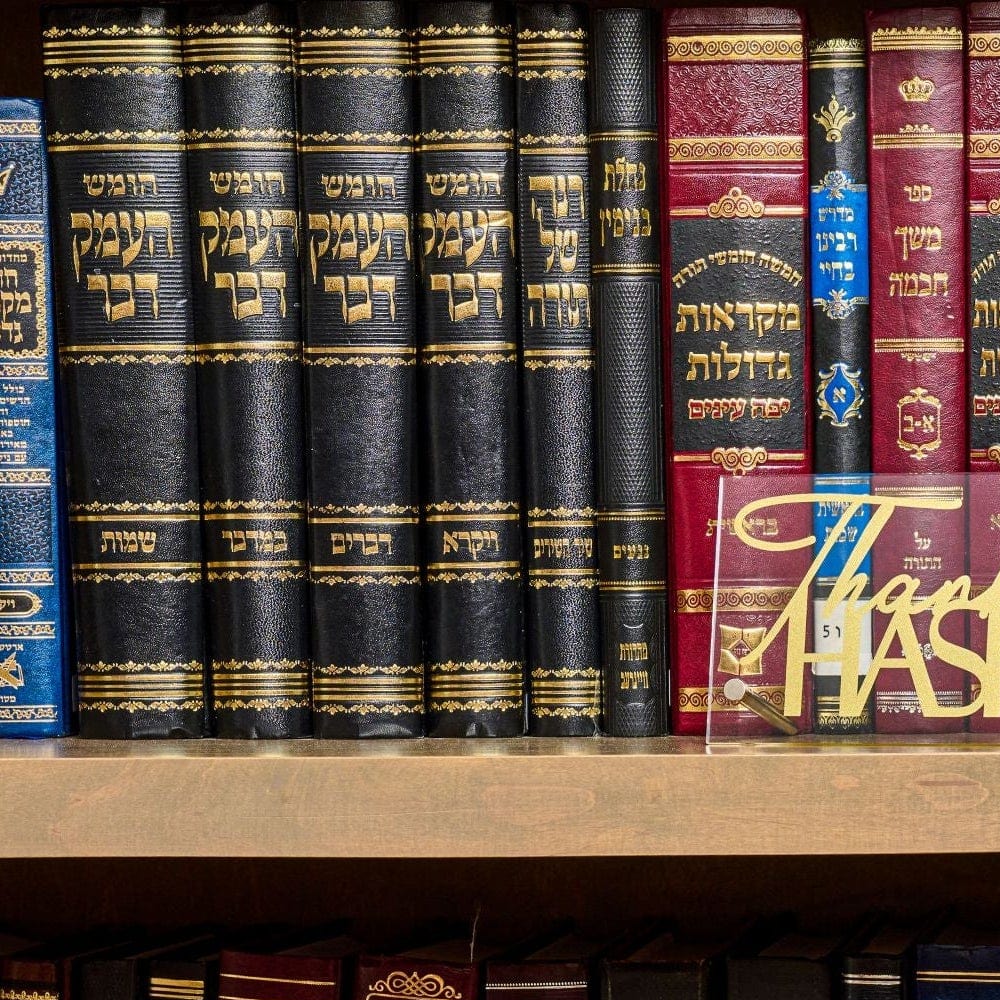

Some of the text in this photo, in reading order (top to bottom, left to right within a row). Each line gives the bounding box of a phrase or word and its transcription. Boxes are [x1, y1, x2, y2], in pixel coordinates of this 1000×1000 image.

[83, 172, 158, 196] חומש
[209, 171, 286, 195] חומש
[321, 173, 396, 198] חומש
[426, 171, 500, 197] חומש
[603, 156, 647, 191] נחלת
[903, 185, 932, 202] ספר
[600, 207, 652, 247] בנימין
[819, 206, 855, 222] מדרש
[71, 208, 174, 283] העמק
[199, 207, 299, 282] העמק
[308, 209, 411, 284] העמק
[535, 207, 579, 273] של
[894, 225, 943, 260] משך
[672, 249, 803, 289] חמשה חומשי תורה
[819, 261, 855, 281] בחיי
[87, 273, 159, 321] דבר
[215, 271, 286, 320] דבר
[430, 271, 503, 322] דבר
[889, 271, 949, 297] חכמה
[324, 273, 396, 324] דבר
[527, 282, 591, 328] תורה
[676, 301, 801, 338] מקראות
[686, 341, 792, 381] גדולות
[832, 386, 847, 404] א
[688, 397, 791, 421] יפה עינים
[904, 415, 935, 433] א-ב
[101, 530, 157, 553] שמות
[222, 529, 288, 552] במדבר
[330, 532, 393, 555] דברים
[442, 531, 500, 560] ויקרא
[913, 532, 931, 550] על
[903, 556, 942, 570] התורה
